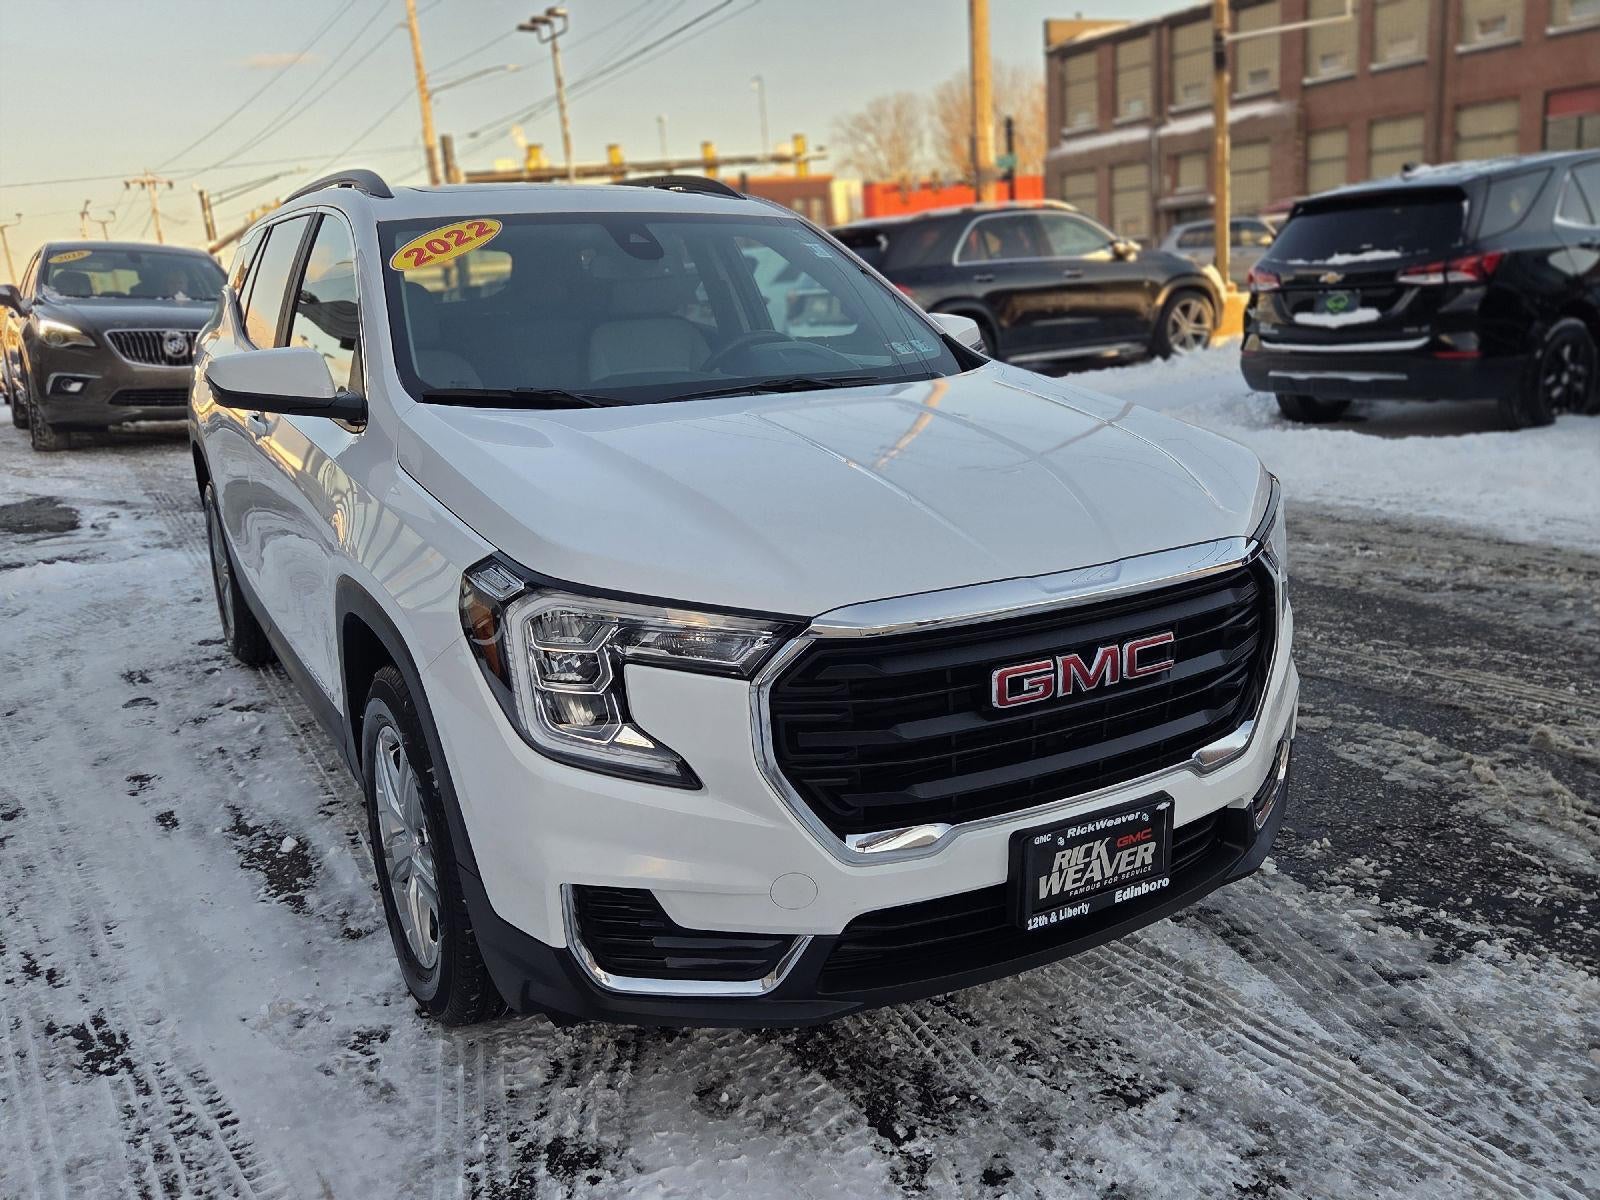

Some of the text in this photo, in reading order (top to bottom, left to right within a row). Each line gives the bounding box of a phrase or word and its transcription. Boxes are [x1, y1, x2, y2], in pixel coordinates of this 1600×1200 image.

[403, 221, 495, 267] 2022
[991, 631, 1175, 709] GMC
[1034, 834, 1052, 845] GMC
[1116, 828, 1152, 848] GMC
[1038, 841, 1157, 900] WEAVER
[1052, 837, 1112, 873] RICK
[1069, 865, 1152, 897] FAMOUS FOR SERVICE
[1114, 877, 1170, 904] Edinboro
[1027, 902, 1091, 931] 12th & Liberty
